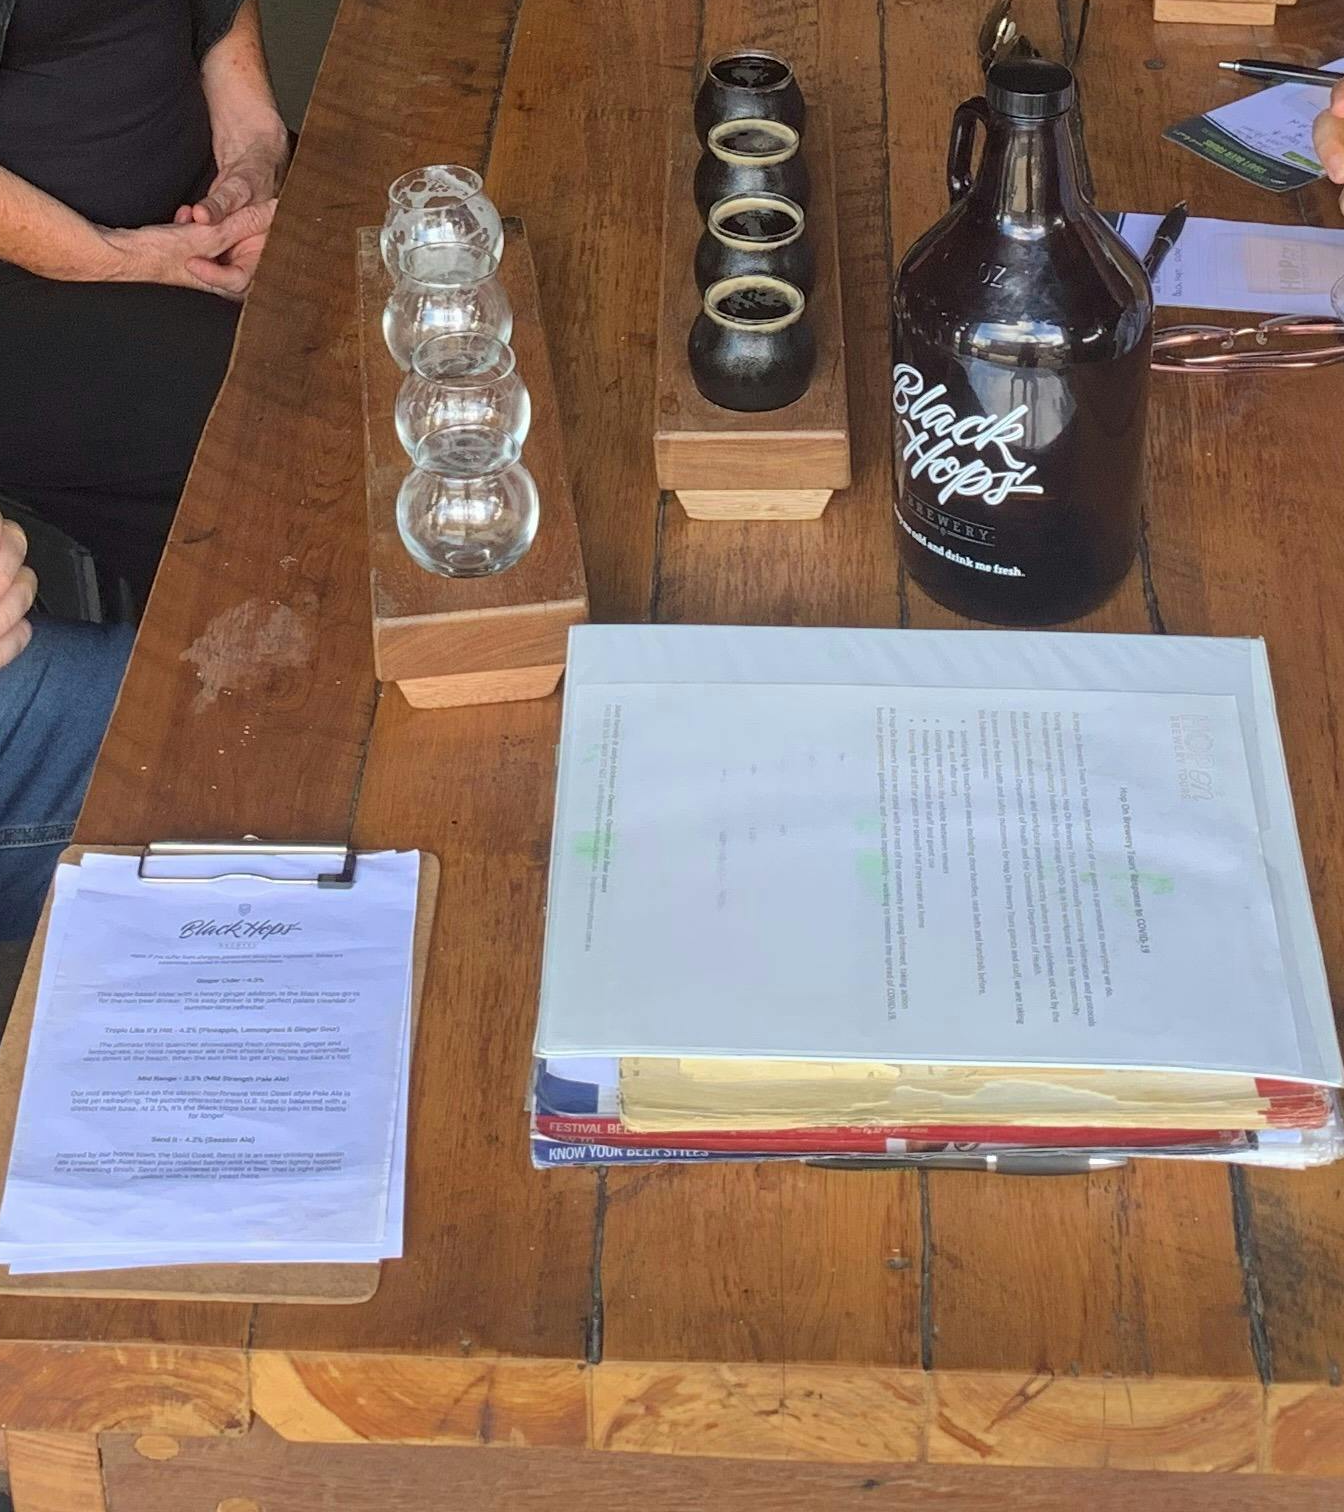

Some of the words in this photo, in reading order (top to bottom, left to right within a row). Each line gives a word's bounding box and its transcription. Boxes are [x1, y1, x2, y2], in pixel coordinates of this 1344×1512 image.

[892, 363, 1029, 469] Black
[902, 419, 1044, 506] Hops
[927, 541, 944, 556] and
[945, 549, 973, 568] drink
[975, 561, 992, 572] me
[993, 564, 1026, 577] fresh.
[1119, 787, 1130, 802] Hop
[1122, 816, 1135, 849] Brewery
[1128, 850, 1138, 872] Tours'
[1129, 873, 1143, 907] Response
[179, 920, 244, 939] Black
[243, 920, 302, 940] Hops
[1137, 918, 1150, 953] COVID-19
[549, 1122, 603, 1135] FESTIVAL
[549, 1147, 586, 1160] KNOW
[589, 1145, 623, 1158] YOUR
